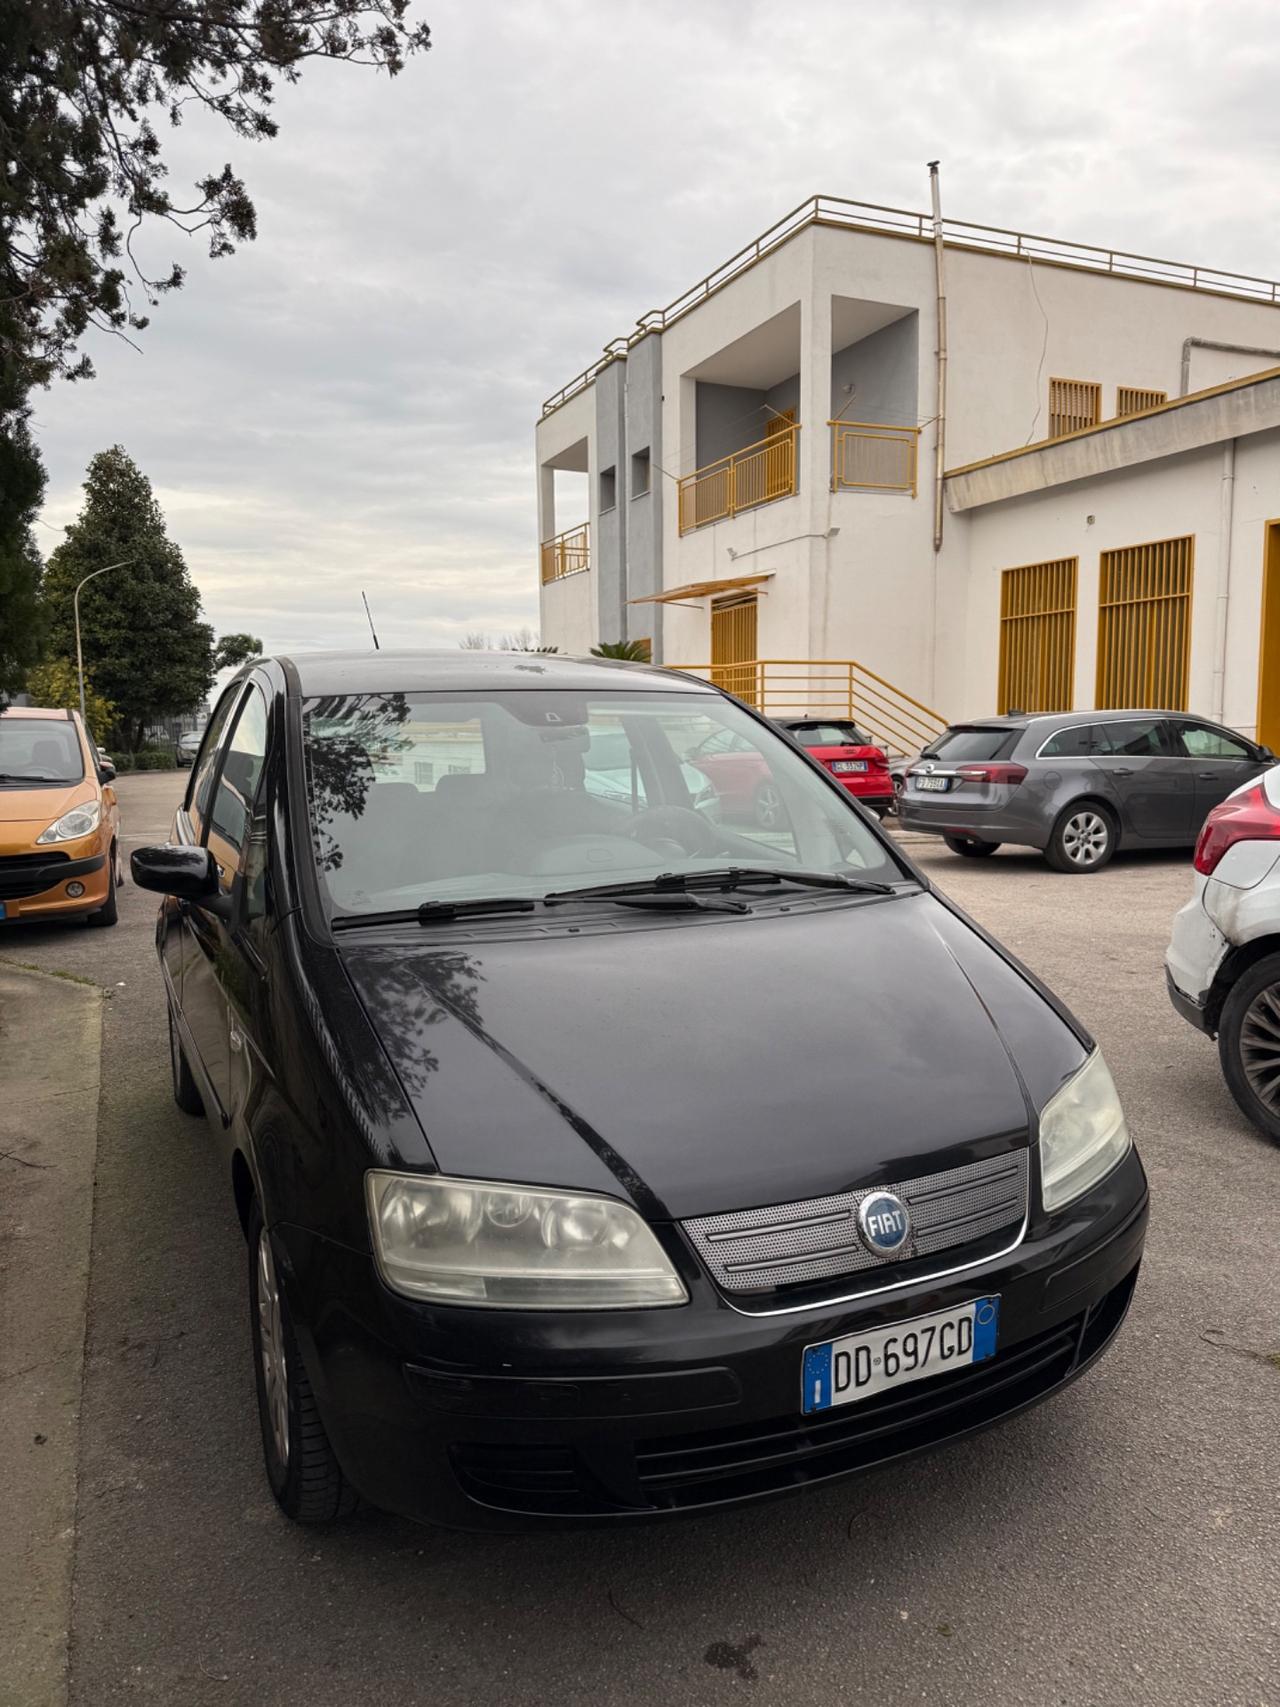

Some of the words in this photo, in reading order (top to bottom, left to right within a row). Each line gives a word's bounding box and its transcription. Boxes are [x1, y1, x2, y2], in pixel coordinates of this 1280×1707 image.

[867, 1210, 903, 1237] FIAT
[834, 1345, 872, 1393] DD
[883, 1316, 973, 1378] 697GD
